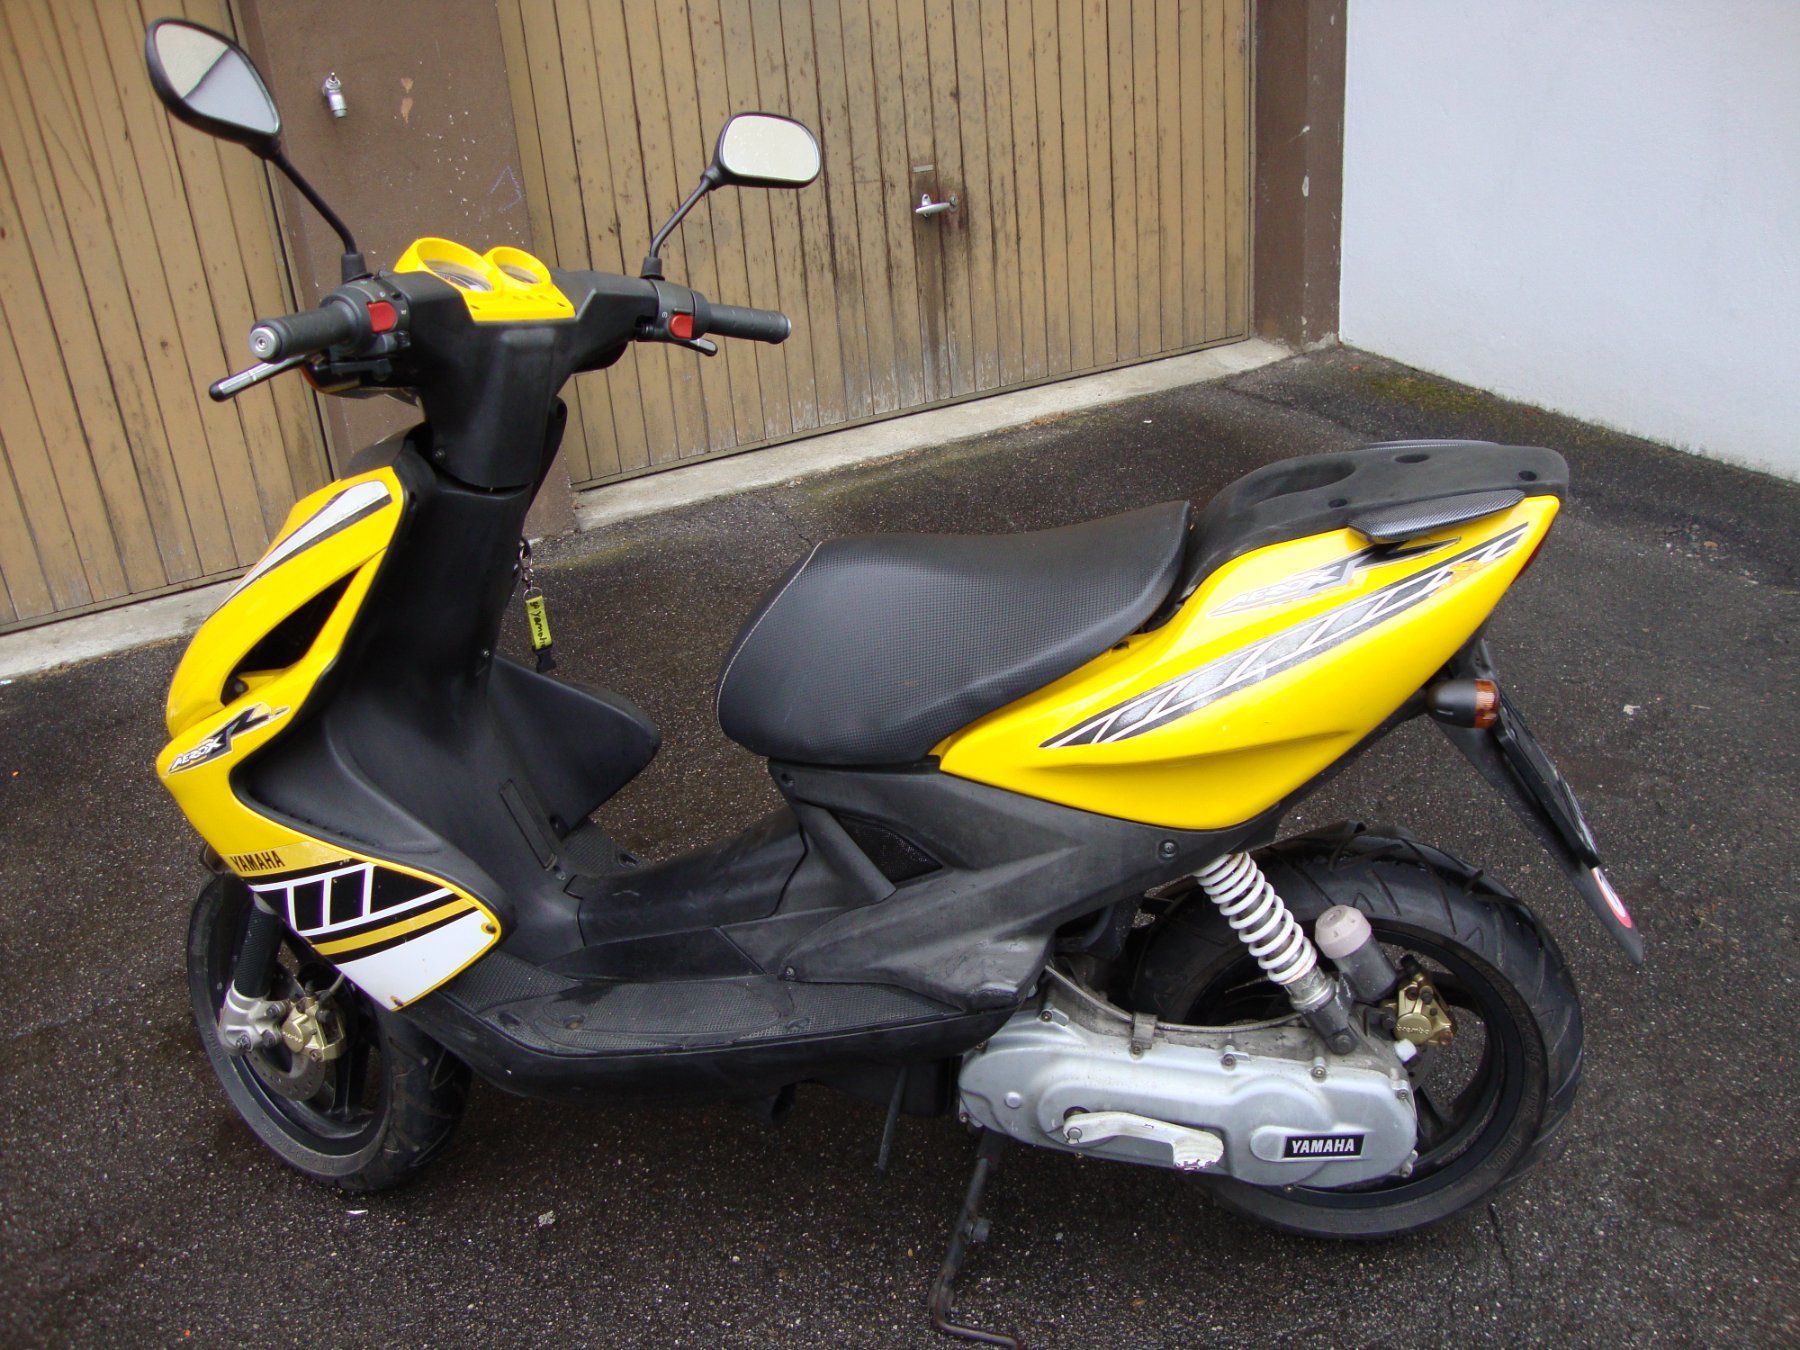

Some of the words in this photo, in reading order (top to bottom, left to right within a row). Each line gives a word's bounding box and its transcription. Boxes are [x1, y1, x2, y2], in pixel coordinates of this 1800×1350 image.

[169, 737, 223, 772] AEROX
[230, 850, 286, 872] YAMAHA
[1291, 1138, 1355, 1154] YAMAHA
